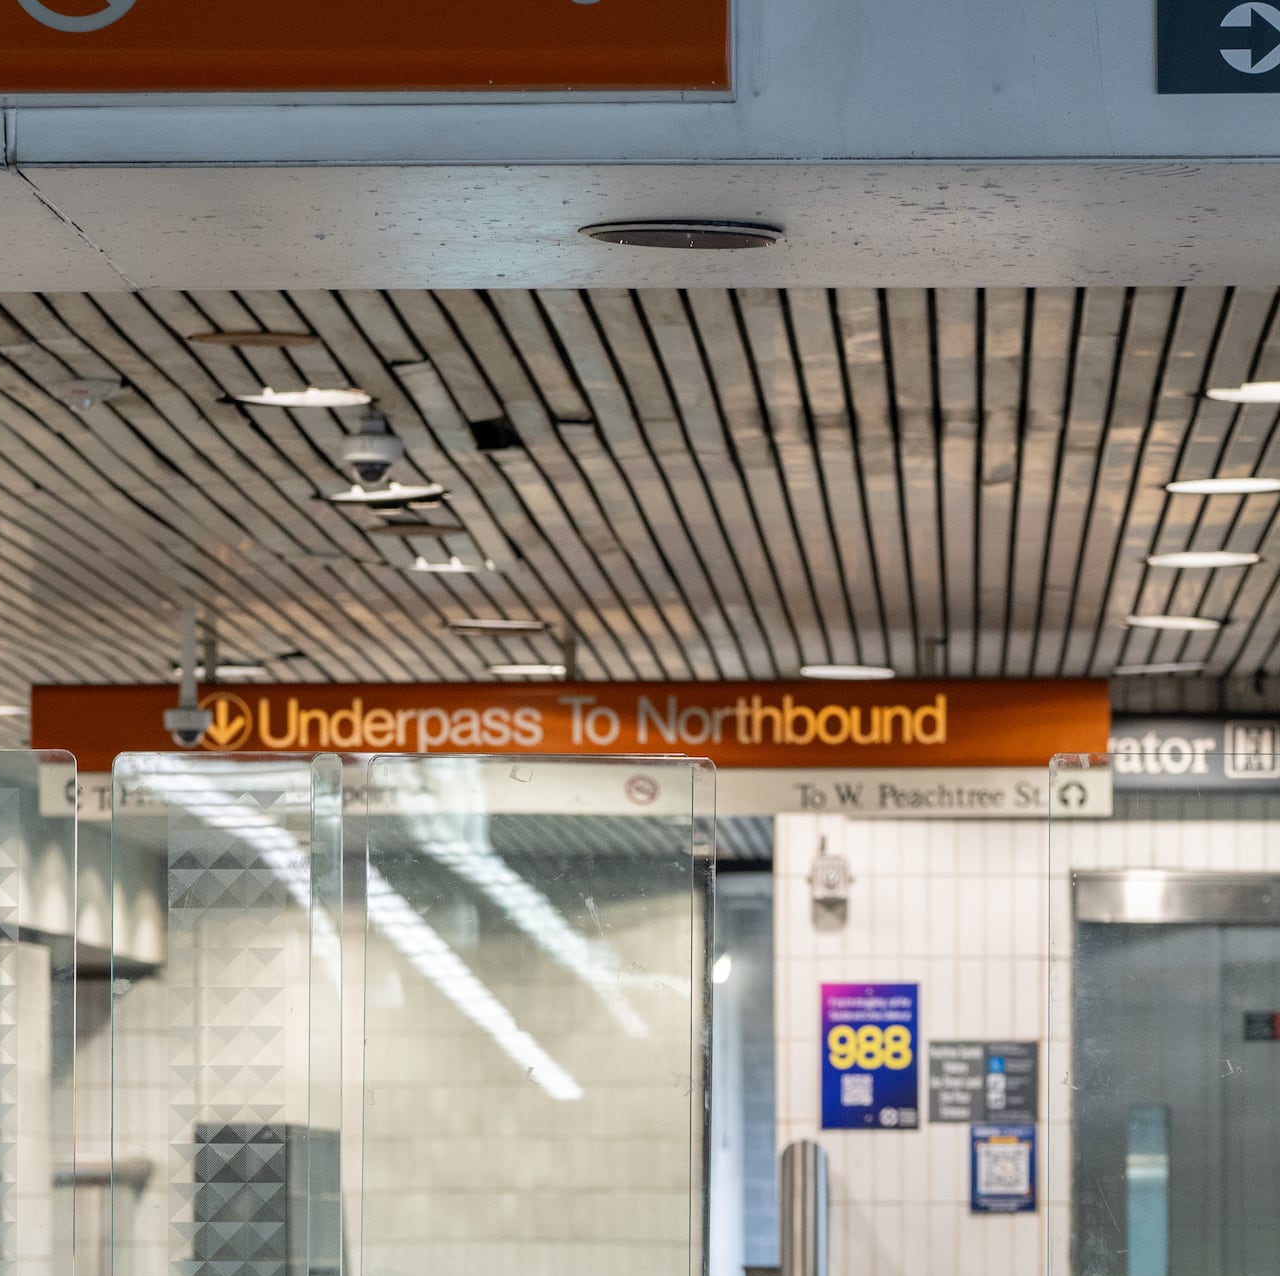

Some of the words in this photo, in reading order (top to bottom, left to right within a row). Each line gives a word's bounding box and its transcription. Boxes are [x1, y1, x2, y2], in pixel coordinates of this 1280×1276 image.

[257, 697, 544, 754] Underpass
[559, 695, 620, 746] To
[636, 692, 948, 746] Northbound
[1109, 730, 1217, 775] ator
[794, 781, 827, 808] To
[877, 782, 1005, 808] Peachtree
[827, 1024, 913, 1070] 988
